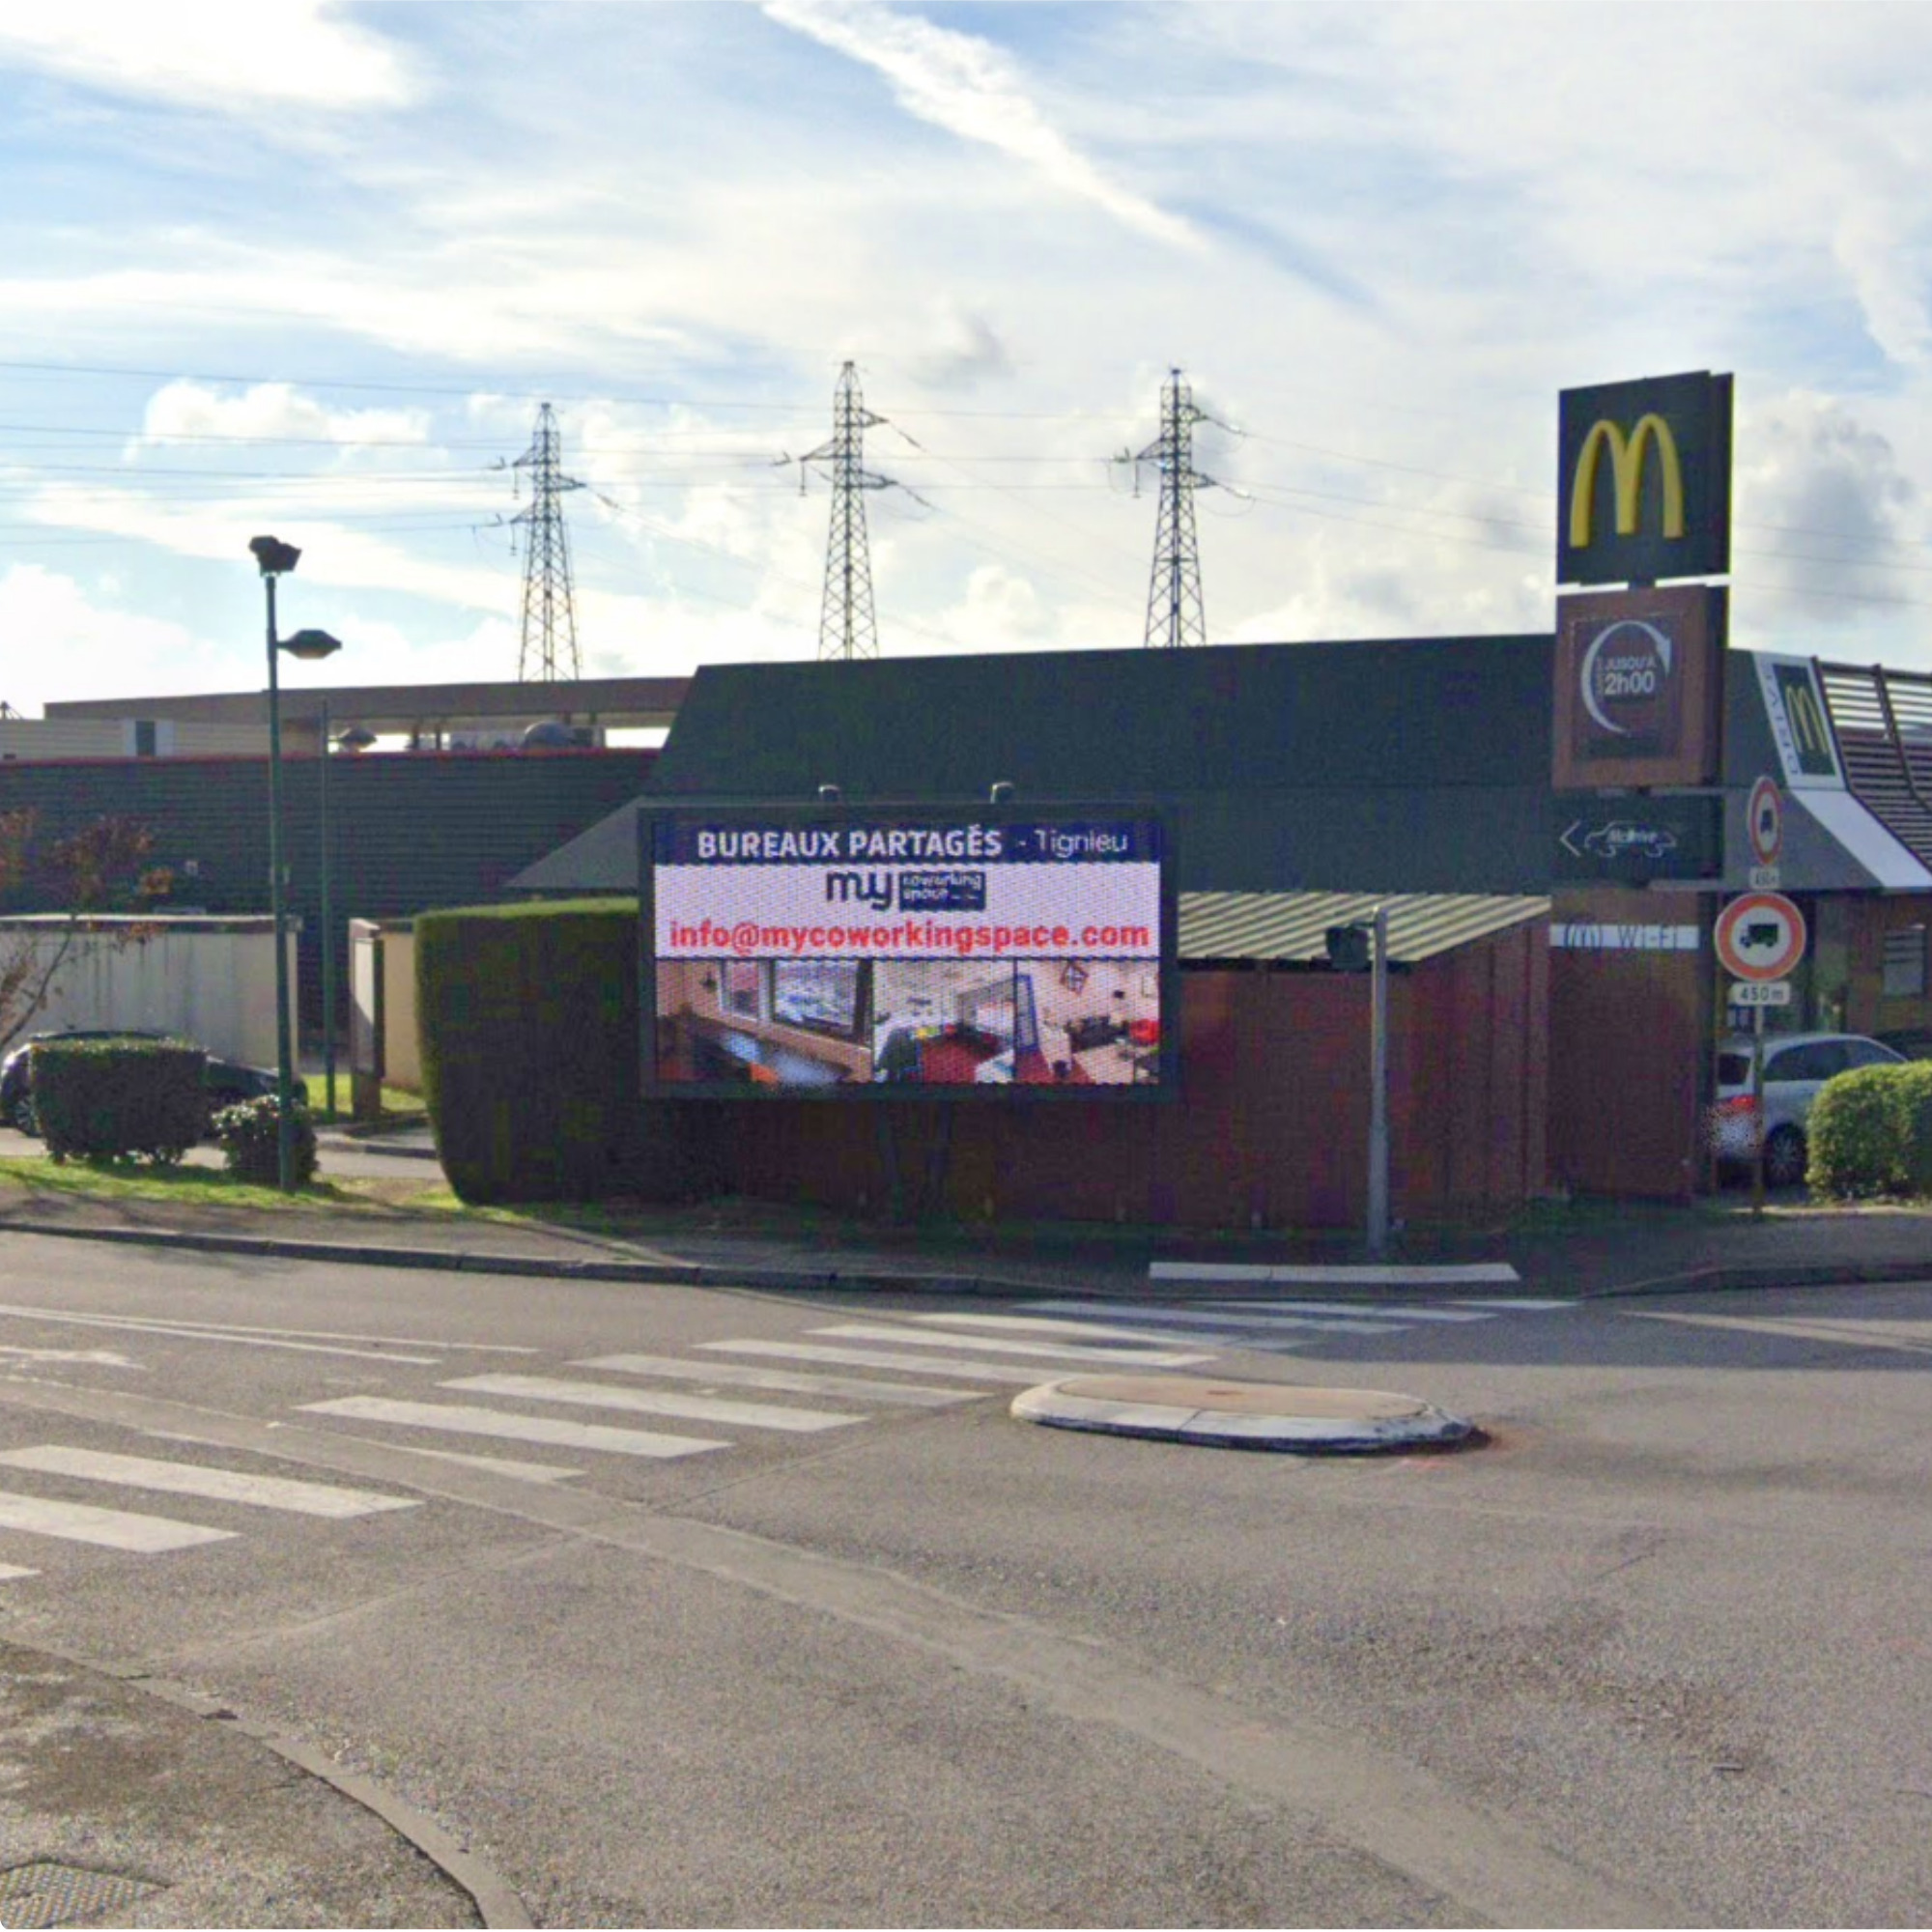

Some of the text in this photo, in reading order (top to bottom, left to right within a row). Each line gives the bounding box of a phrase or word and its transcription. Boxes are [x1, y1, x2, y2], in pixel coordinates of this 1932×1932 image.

[1604, 669, 1656, 695] 2h00
[697, 831, 840, 858] BUREAUX
[848, 824, 1002, 857] PARTAGÉS
[826, 870, 893, 911] my
[668, 919, 1150, 955] info@mycoworkingspace.com
